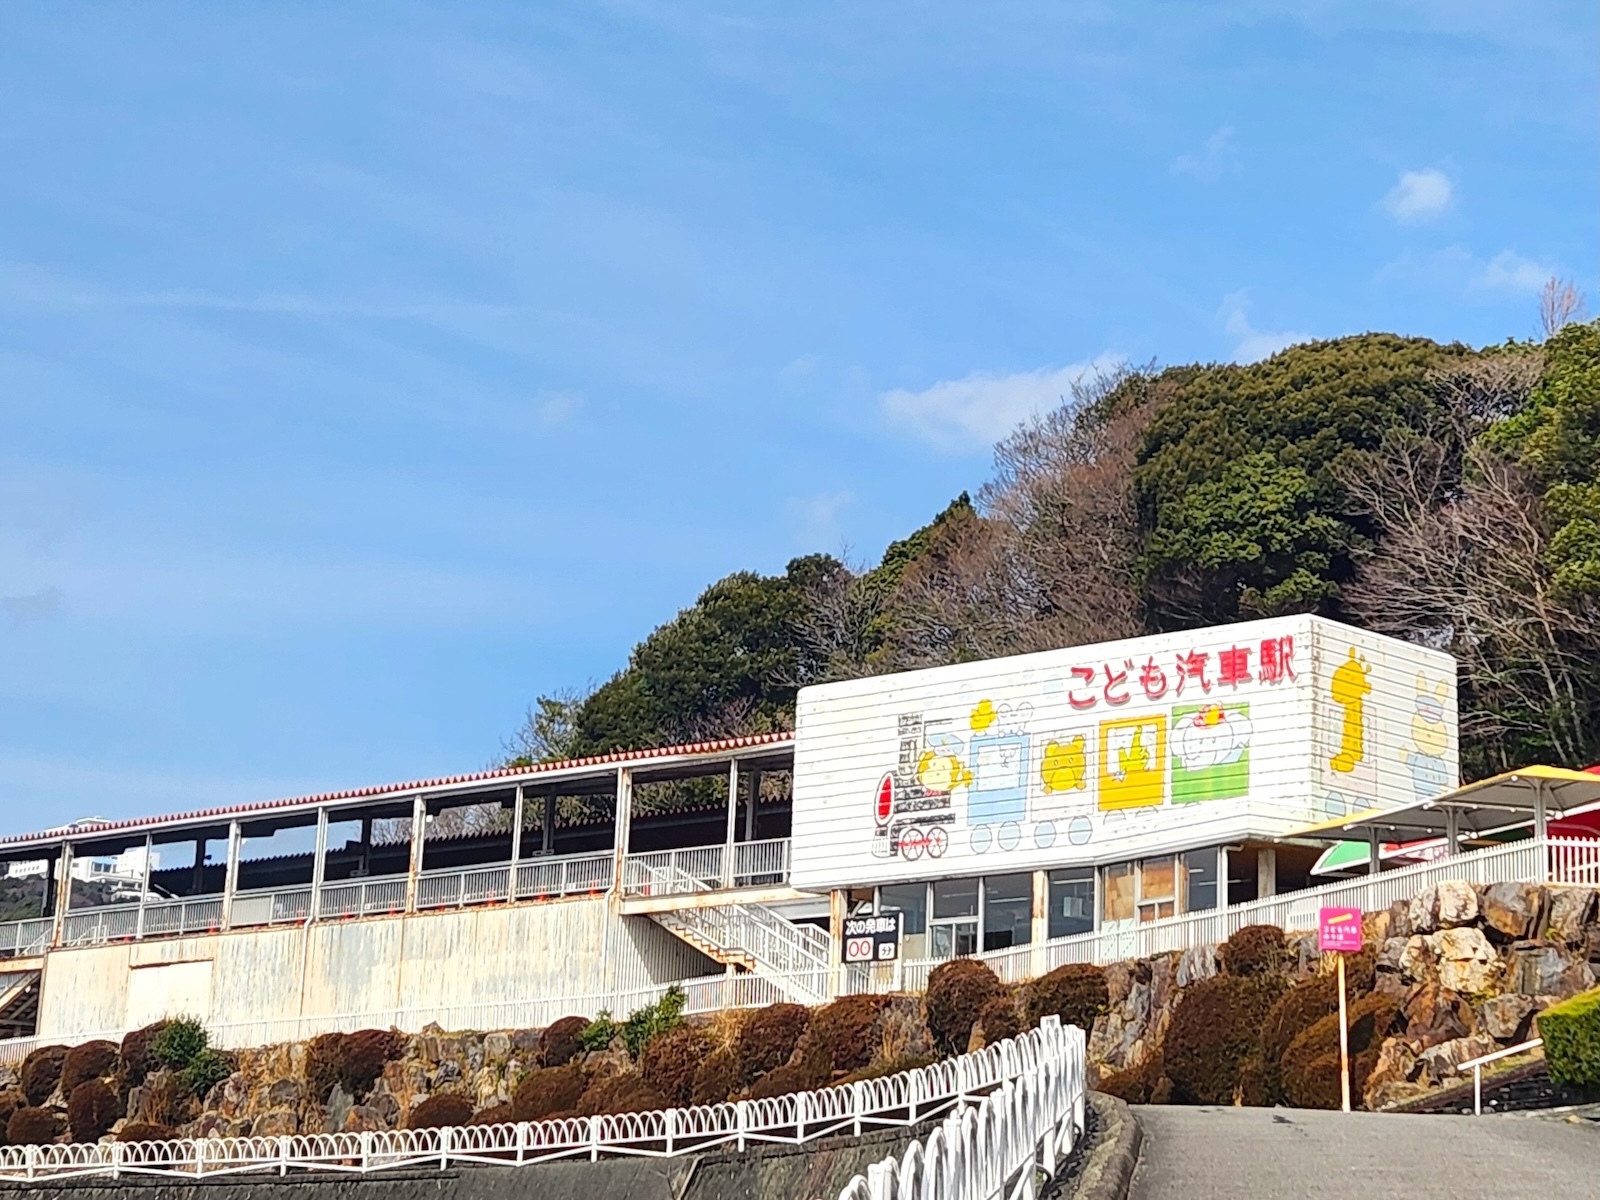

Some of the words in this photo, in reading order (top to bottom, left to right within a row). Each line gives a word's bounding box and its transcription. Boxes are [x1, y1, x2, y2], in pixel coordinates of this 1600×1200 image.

[1068, 634, 1298, 708] こども汽車駅
[845, 917, 897, 936] 次の発車は
[881, 945, 892, 956] 分
